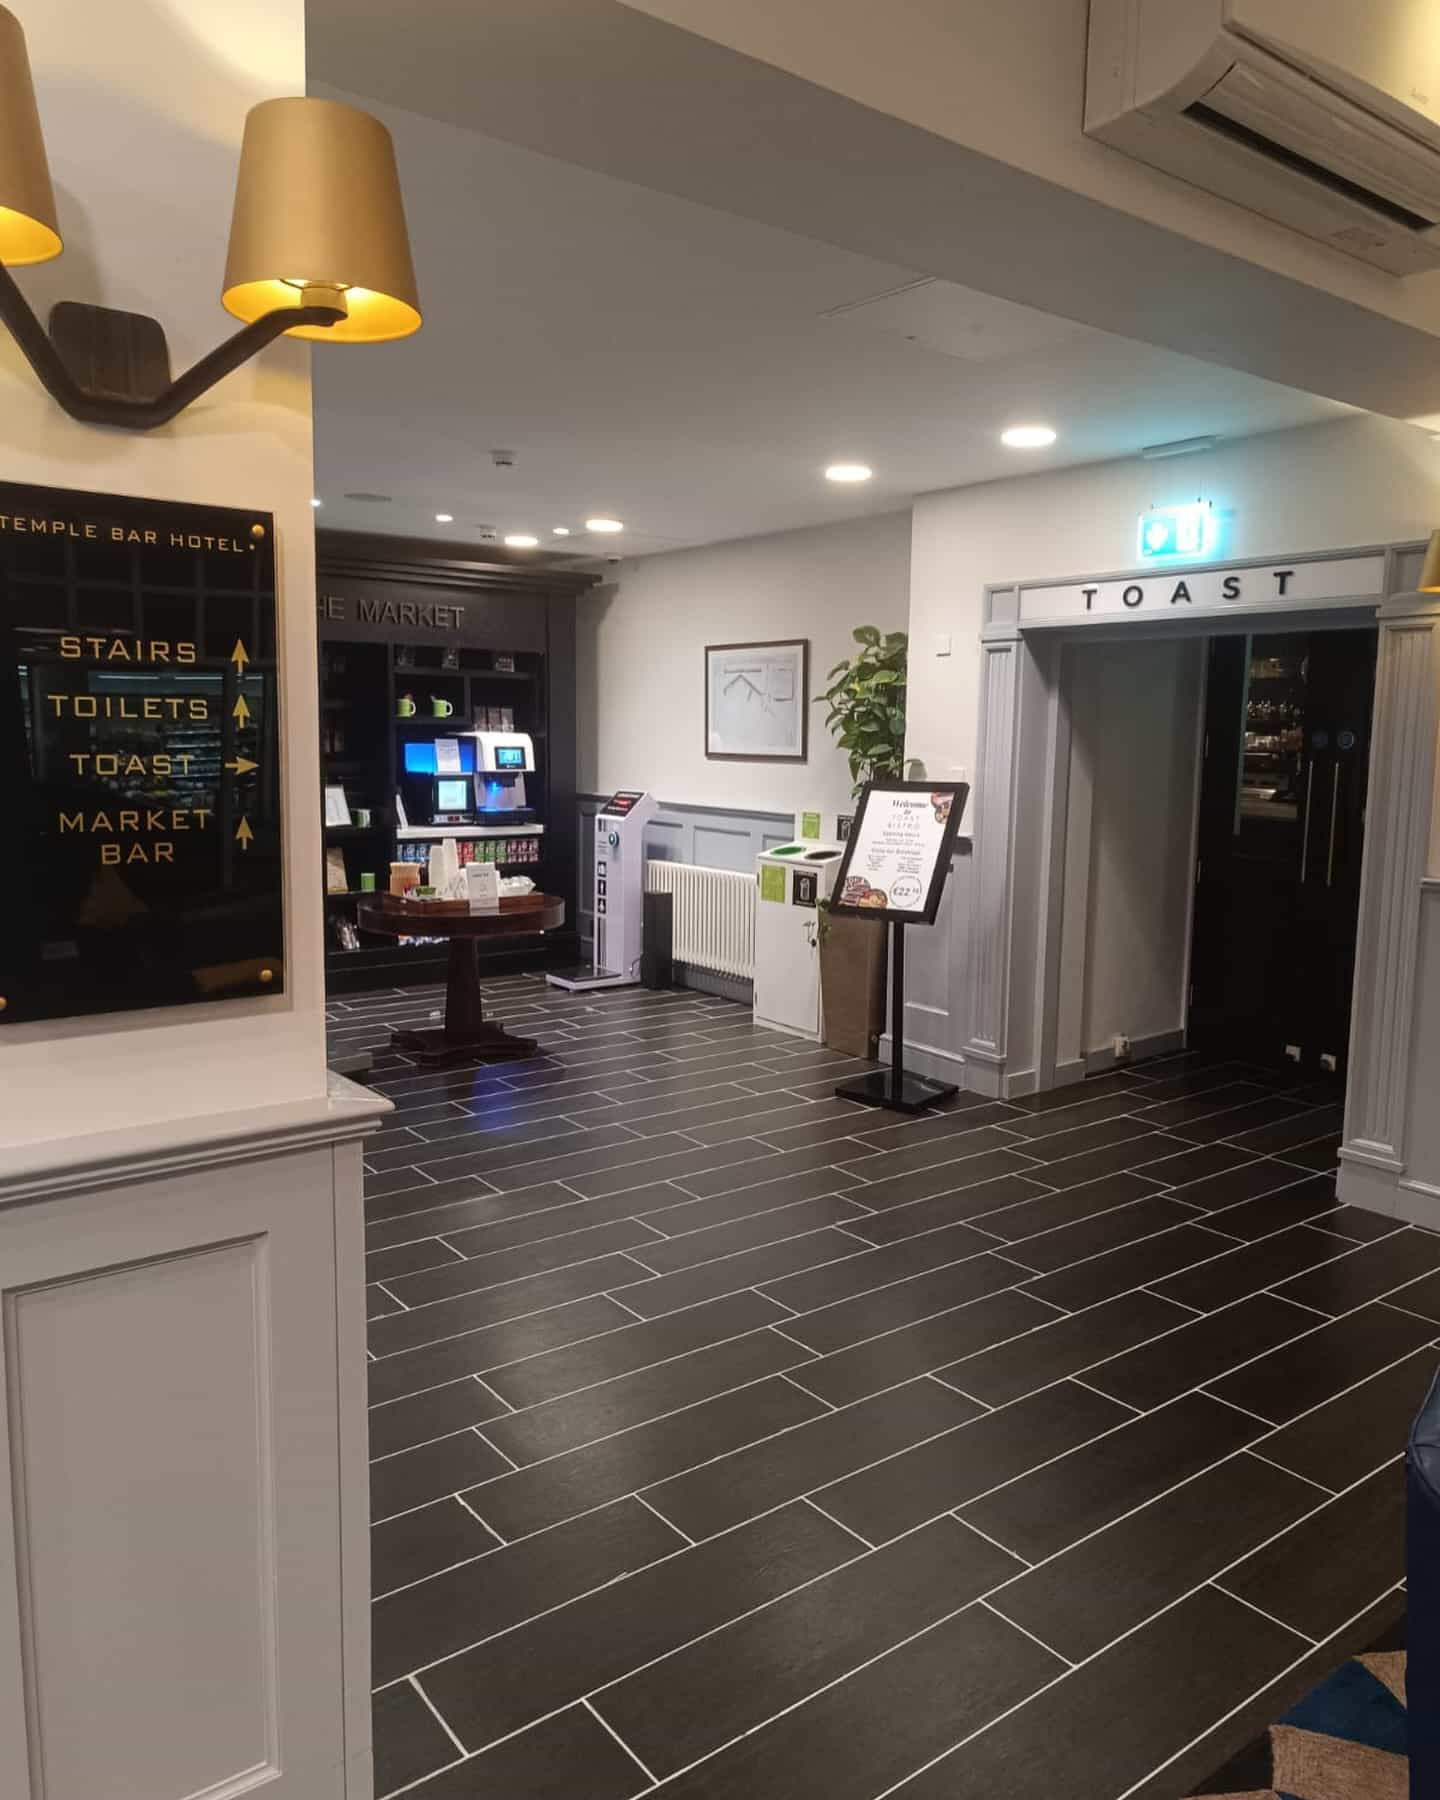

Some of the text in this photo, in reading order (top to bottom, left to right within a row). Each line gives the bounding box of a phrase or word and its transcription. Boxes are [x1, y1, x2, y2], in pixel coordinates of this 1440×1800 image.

[0, 515, 244, 553] TEMPLE BAR HOTEL
[1082, 571, 1294, 611] TOAST
[318, 596, 465, 630] HE MARKET
[60, 636, 197, 664] STAIRS
[47, 695, 209, 720] TOILETS
[69, 753, 195, 777] TOAST
[59, 808, 212, 834] MARKET
[101, 842, 174, 865] BAR
